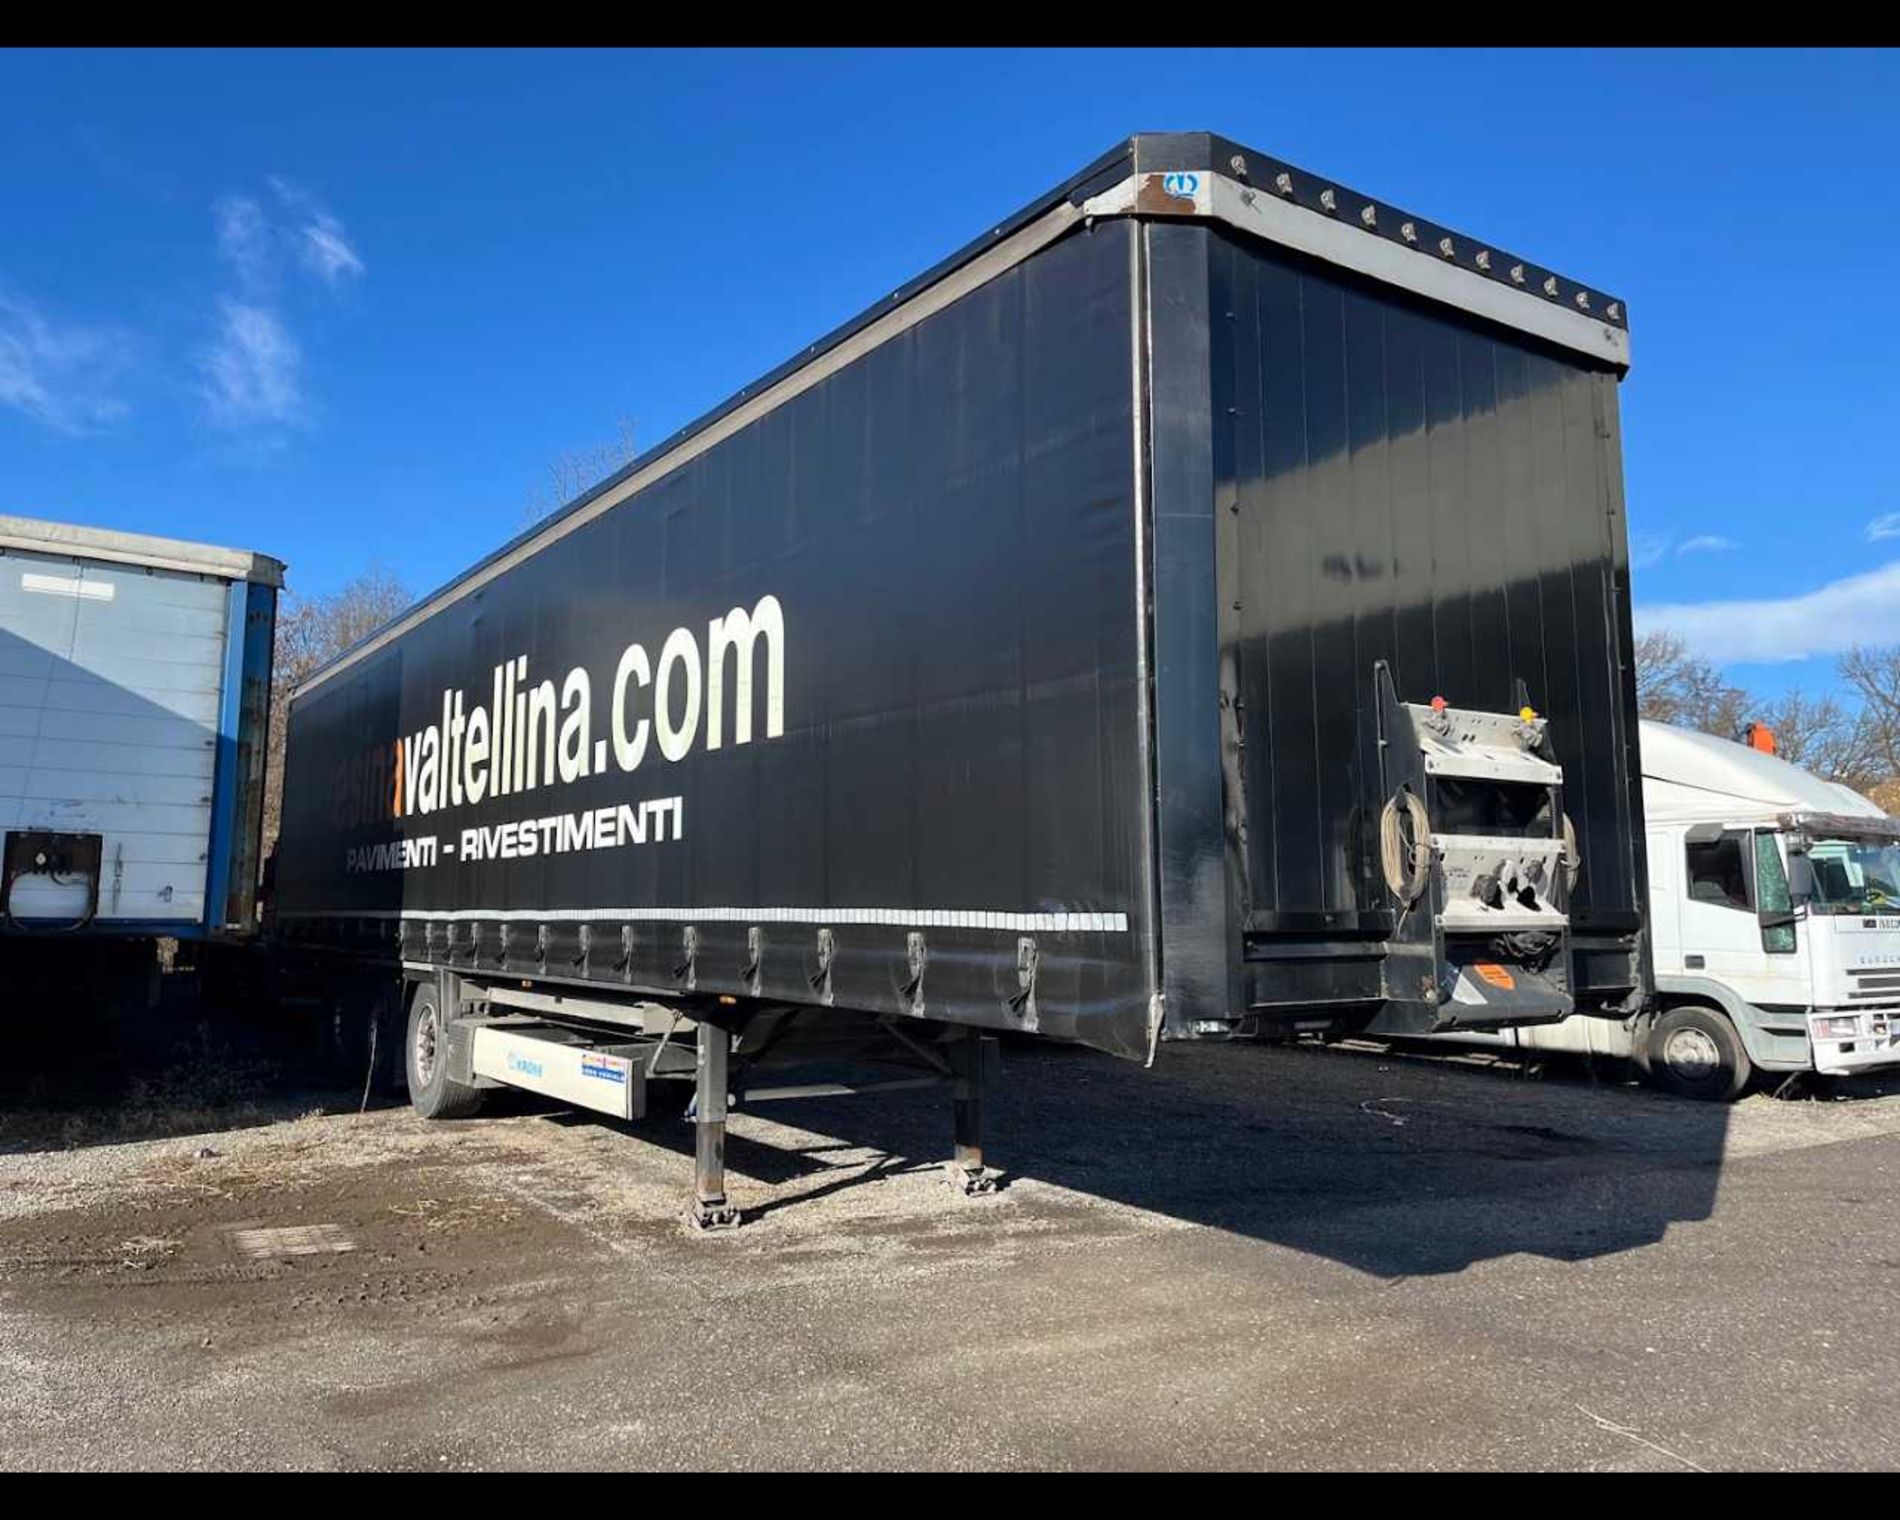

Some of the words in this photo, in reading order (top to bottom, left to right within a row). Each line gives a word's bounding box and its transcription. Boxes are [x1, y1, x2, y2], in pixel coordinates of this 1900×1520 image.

[346, 836, 437, 874] PAVIMENTI
[443, 843, 454, 854] -
[460, 796, 683, 862] RIVESTIMENTI
